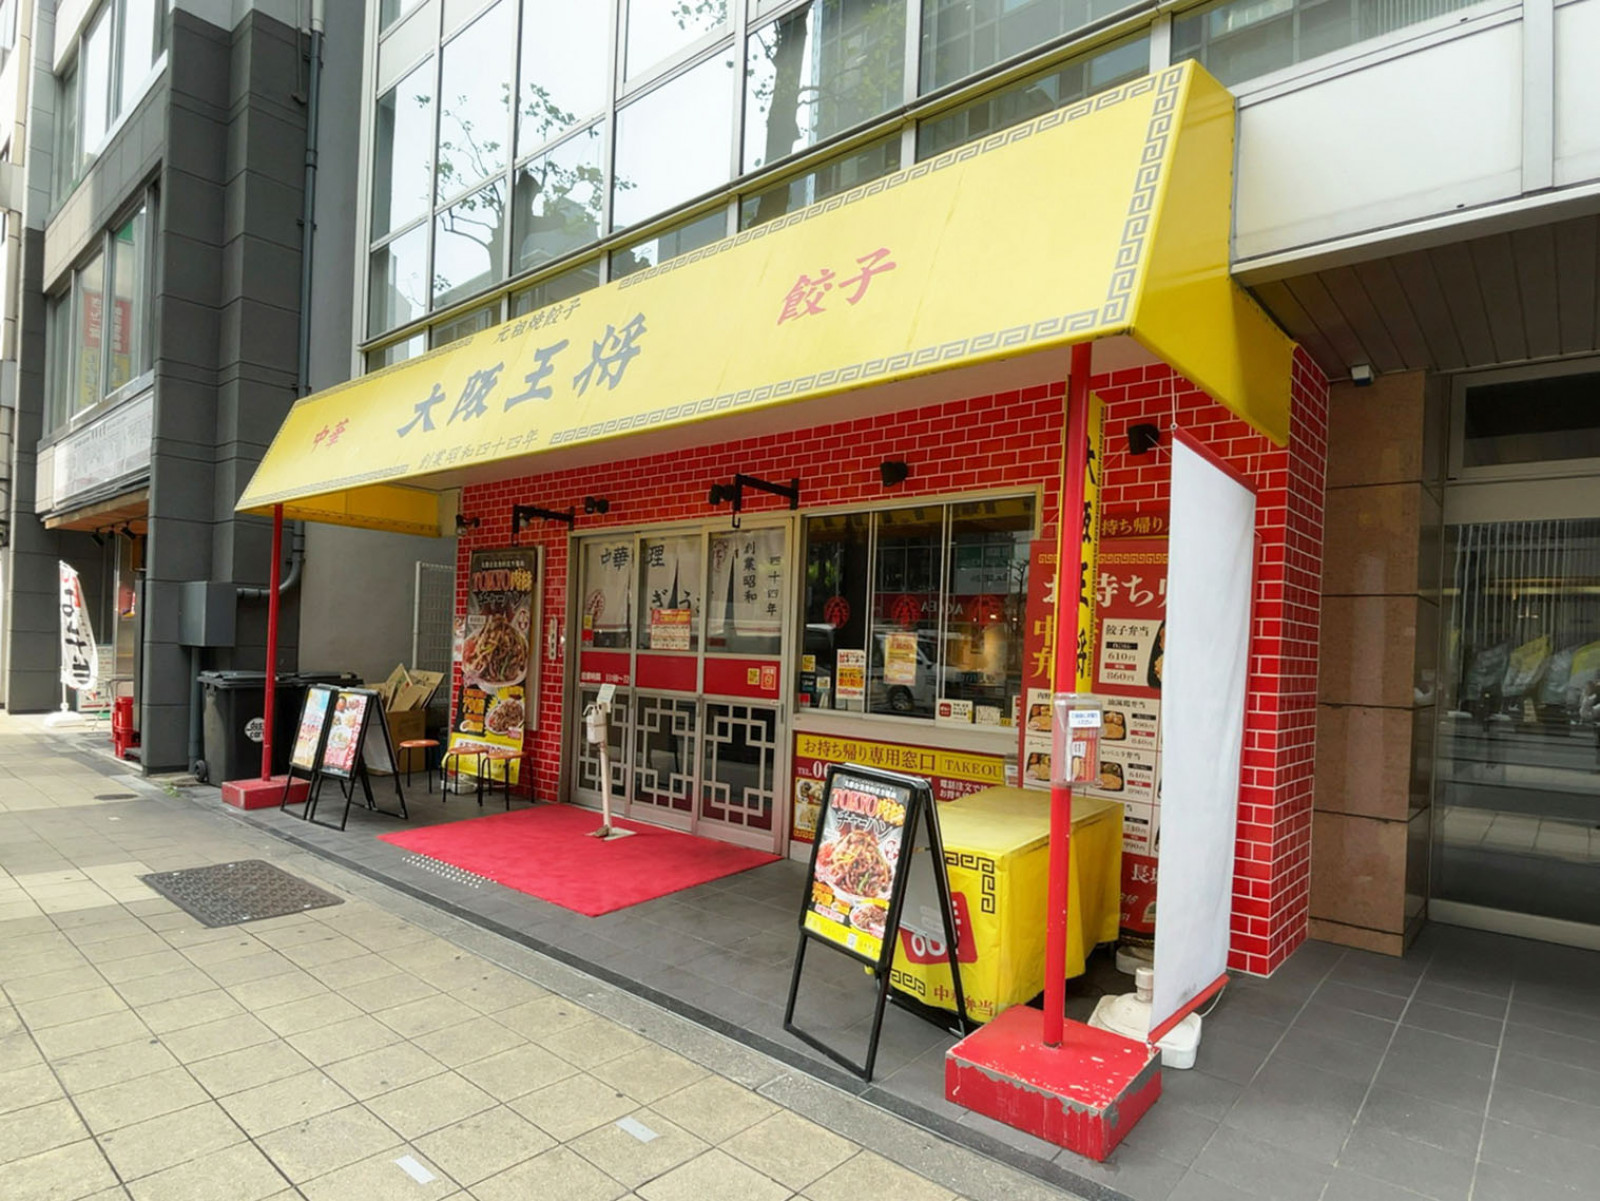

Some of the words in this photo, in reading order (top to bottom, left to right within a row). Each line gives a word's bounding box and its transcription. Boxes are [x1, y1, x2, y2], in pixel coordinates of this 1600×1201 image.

[776, 247, 897, 326] 餃子
[491, 297, 582, 345] 元祖焼餃子
[396, 312, 648, 438] 大阪王将
[311, 418, 350, 455] 中華
[418, 429, 540, 471] 創業昭和四十四年
[1102, 515, 1168, 537] 持ち帰り
[766, 555, 782, 617] 四十四年
[1106, 624, 1150, 637] 餃子弁当
[1108, 652, 1136, 662] 610円
[1106, 671, 1135, 682] 860円
[803, 739, 936, 772] お持ち帰り専用窓口
[831, 788, 878, 817] TOKYO
[934, 984, 994, 1017] 中弁当
